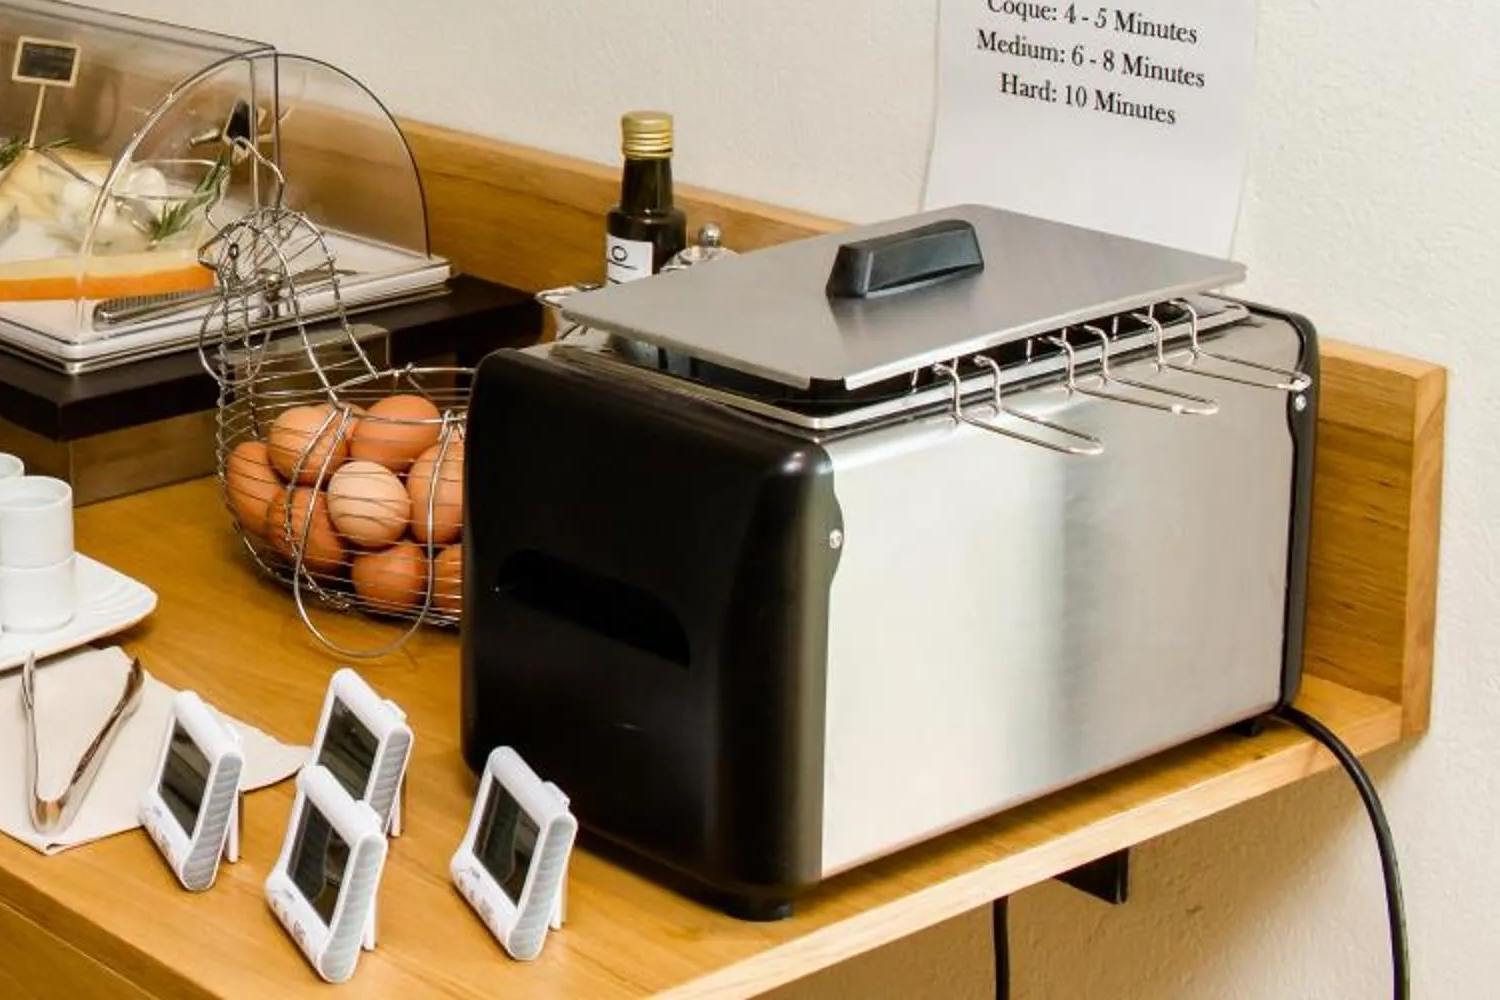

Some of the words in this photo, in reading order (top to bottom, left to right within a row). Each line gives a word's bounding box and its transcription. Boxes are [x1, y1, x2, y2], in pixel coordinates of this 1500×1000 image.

[1063, 2, 1077, 25] 4
[1093, 7, 1107, 29] 5
[1113, 9, 1198, 44] Minutes
[976, 28, 1066, 64] Medium:
[1071, 44, 1085, 67] 6
[1102, 49, 1115, 73] 8
[1121, 52, 1205, 89] Minutes
[1000, 71, 1057, 103] Hard:
[1065, 84, 1088, 108] 10
[1093, 88, 1176, 125] Minutes
